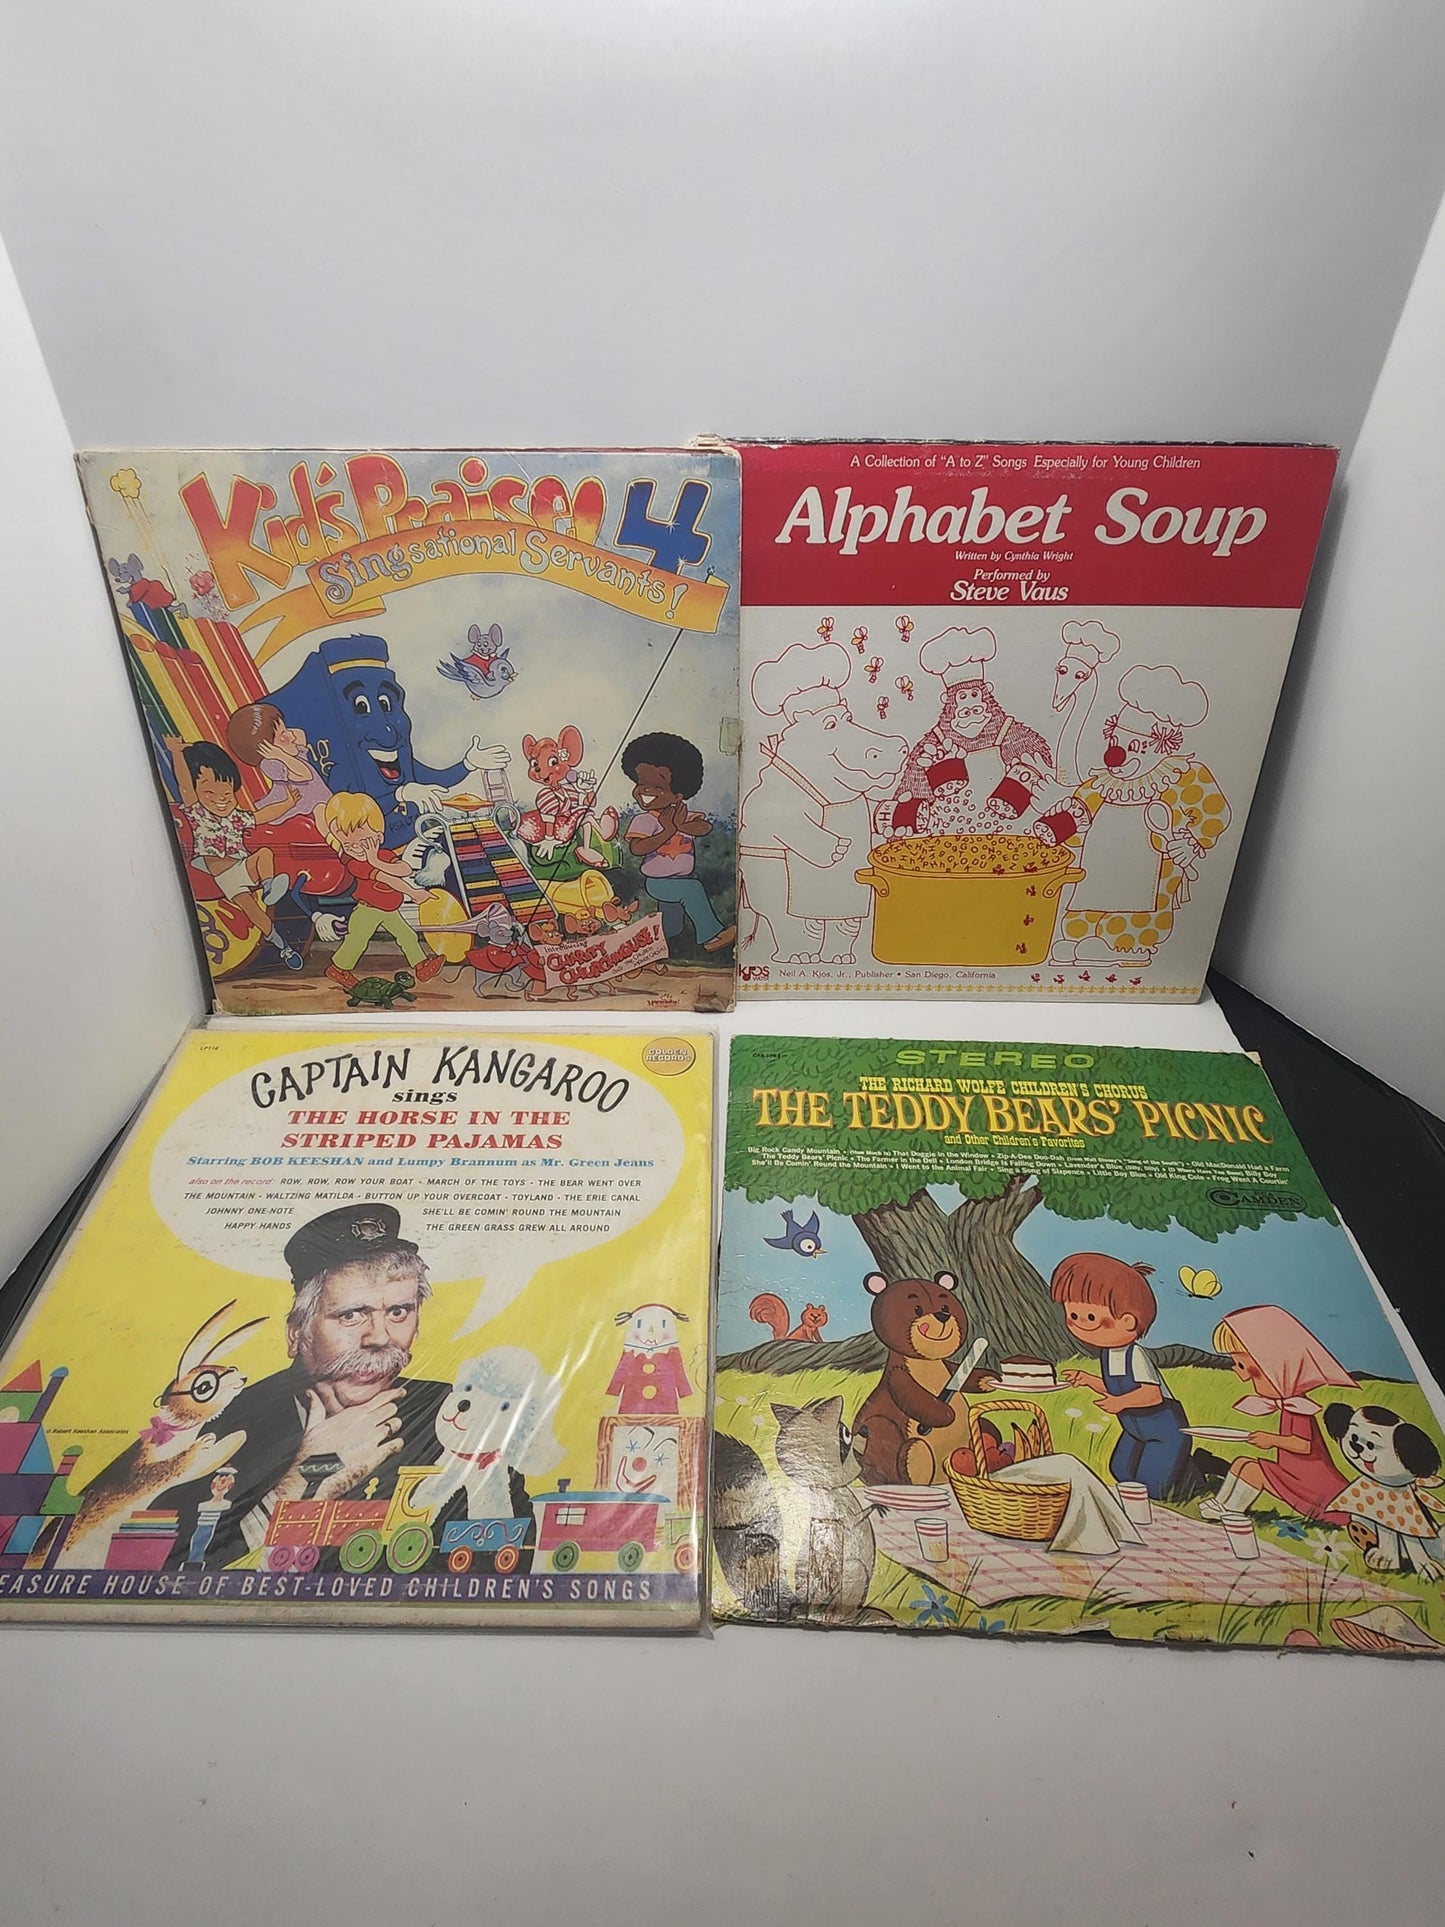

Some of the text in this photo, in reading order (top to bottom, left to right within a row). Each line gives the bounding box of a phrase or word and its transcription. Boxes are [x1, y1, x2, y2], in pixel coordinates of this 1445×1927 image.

[850, 455, 861, 468] A
[865, 455, 920, 468] Collection
[925, 455, 938, 468] of
[941, 455, 956, 468] "A
[959, 457, 971, 468] to
[992, 455, 1027, 470] Songs
[1034, 455, 1088, 470] Especially
[1092, 455, 1107, 468] for
[1113, 455, 1149, 470] Young
[1153, 455, 1201, 469] Children
[775, 485, 1268, 558] Alphabet Soup
[179, 460, 360, 611] Kid's
[614, 478, 712, 575] 4
[955, 550, 1073, 562] Written by Cynthia Wright
[318, 529, 688, 619] Singsational Servants!
[974, 568, 1050, 582] Performed by
[950, 580, 1069, 602] Steve Vaus
[779, 969, 796, 978] Neil
[798, 969, 808, 978] A.
[812, 970, 833, 979] Kjos,
[855, 970, 894, 979] Publisher
[904, 970, 922, 979] San
[955, 971, 996, 980] California
[896, 1049, 1095, 1069] STEREO
[251, 1045, 629, 1113] CAPTAIN KANGAROO
[860, 1076, 1148, 1100] THE RICHARD WOLFE CHILDREN'S CHORUS
[392, 1089, 458, 1105] sings
[287, 1110, 571, 1126] THE HORSE IN THE
[753, 1087, 1274, 1145] THE TEDDY BEARS' PICNIC
[280, 1133, 563, 1150] STRIPED PAJAMAS
[944, 1134, 1086, 1149] and Other Children's Favorites
[187, 1156, 655, 1168] Starring BOB KEESHAN and Lumpy Brannum as Mr. Green Jeans
[747, 1146, 760, 1154] Big
[1206, 1161, 1247, 1170] MacDonald
[778, 1153, 799, 1161] Teddy
[826, 1154, 848, 1162] Picnic
[975, 1158, 999, 1166] Bridge
[1009, 1160, 1034, 1168] Falling
[188, 1177, 208, 1185] also
[224, 1177, 240, 1185] the
[280, 1178, 303, 1186] ROW,
[307, 1178, 330, 1186] ROW,
[360, 1178, 385, 1186] YOUR
[389, 1178, 414, 1186] BOAT
[503, 1179, 526, 1187] TOYS
[538, 1179, 557, 1187] THE
[560, 1179, 584, 1187] BEAR
[1211, 1174, 1231, 1183] Frog
[184, 1192, 201, 1200] THE
[205, 1192, 256, 1200] MOUNTAIN
[265, 1192, 311, 1200] WALTZING
[314, 1192, 354, 1200] MATILDA
[424, 1193, 449, 1201] YOUR
[453, 1193, 502, 1201] OVERCOAT
[564, 1194, 582, 1202] THE
[586, 1194, 607, 1202] ERIE
[205, 1207, 295, 1215] JOHNNY ONE-NOTE
[422, 1208, 455, 1216] SHE'LL
[458, 1208, 471, 1216] BE
[474, 1208, 508, 1216] COMIN'
[571, 1209, 621, 1217] MOUNTAIN
[224, 1222, 292, 1230] HAPPY HANDS
[426, 1223, 610, 1232] THE GREEN GRASS GREW ALL AROUND
[103, 1574, 185, 1596] HOUSE
[199, 1575, 229, 1596] OF
[241, 1575, 393, 1597] BEST-LOVED
[407, 1577, 554, 1599] CHILDREN'S
[569, 1579, 651, 1600] SONGS
